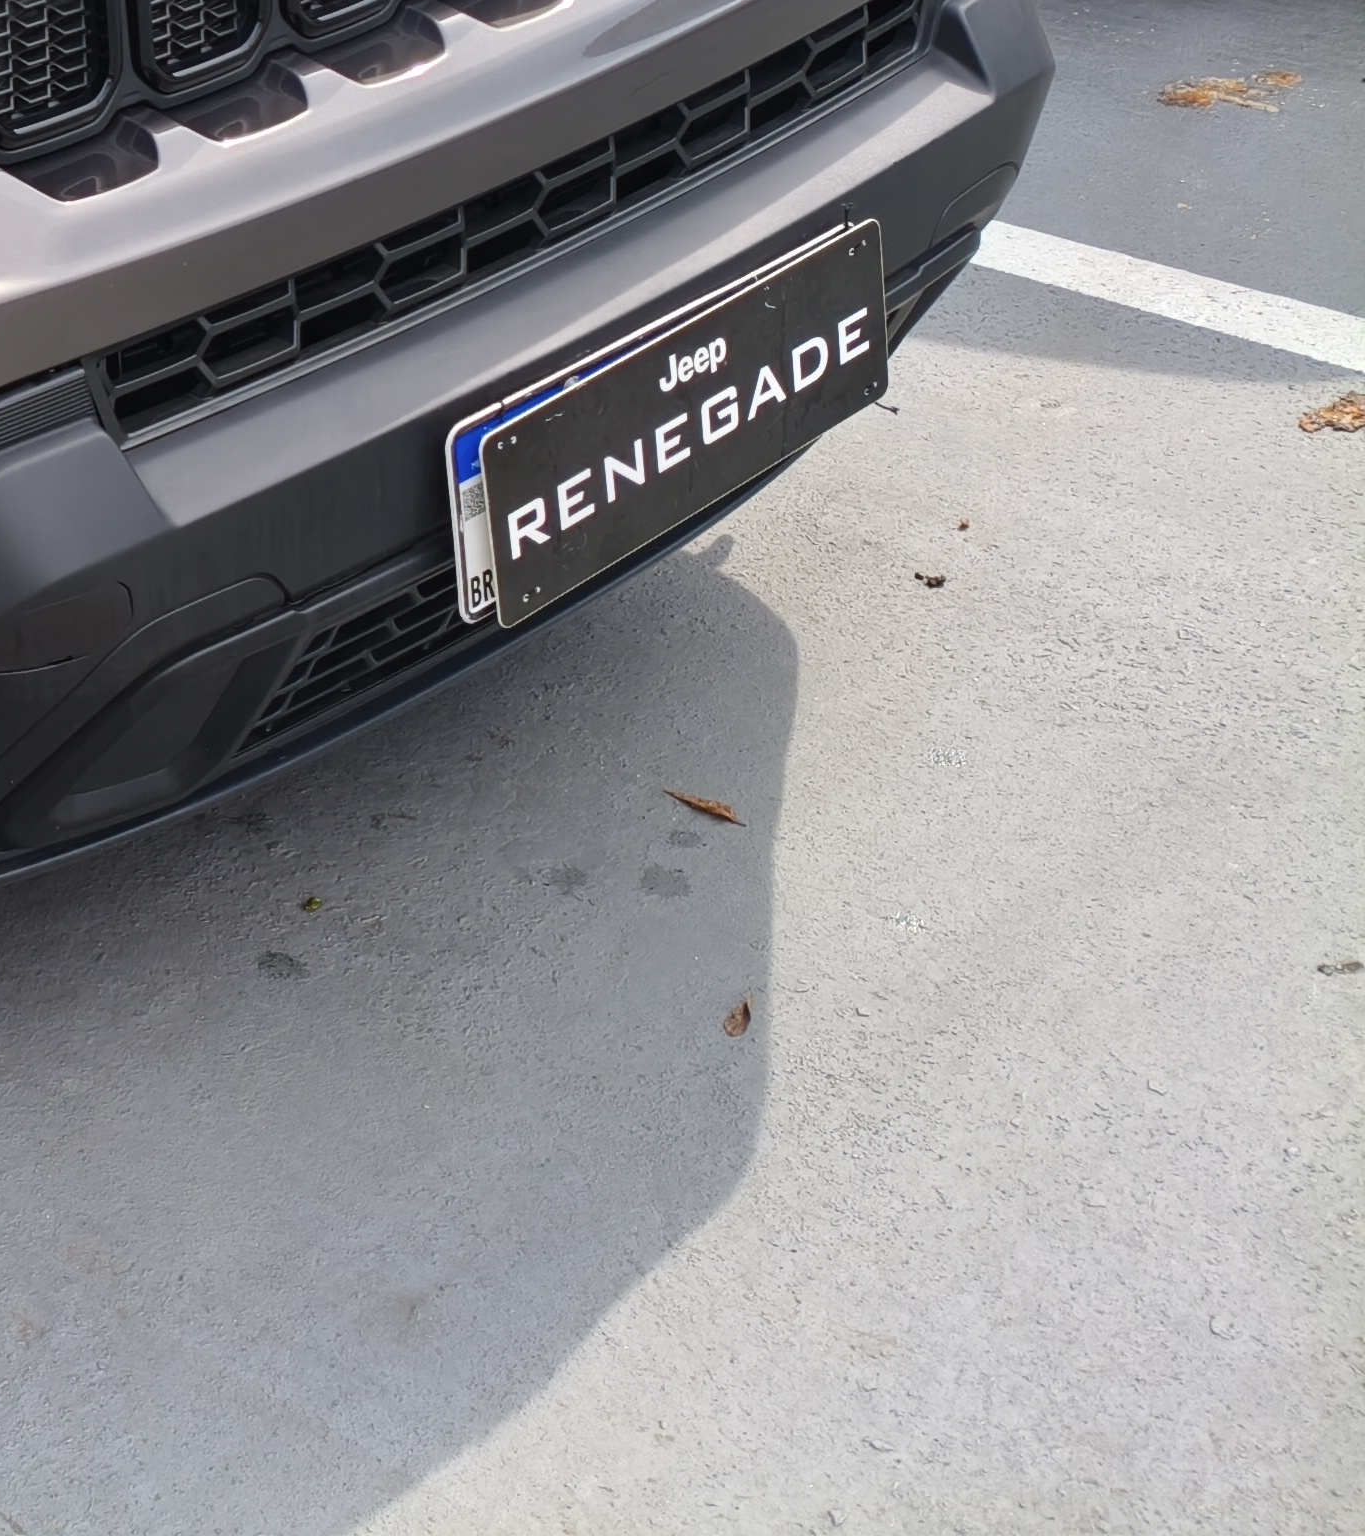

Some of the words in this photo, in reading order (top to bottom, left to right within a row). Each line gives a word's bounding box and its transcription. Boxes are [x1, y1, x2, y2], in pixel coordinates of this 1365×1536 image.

[659, 336, 727, 392] Jeep
[507, 307, 870, 561] RENEGADE
[471, 569, 495, 608] BR
